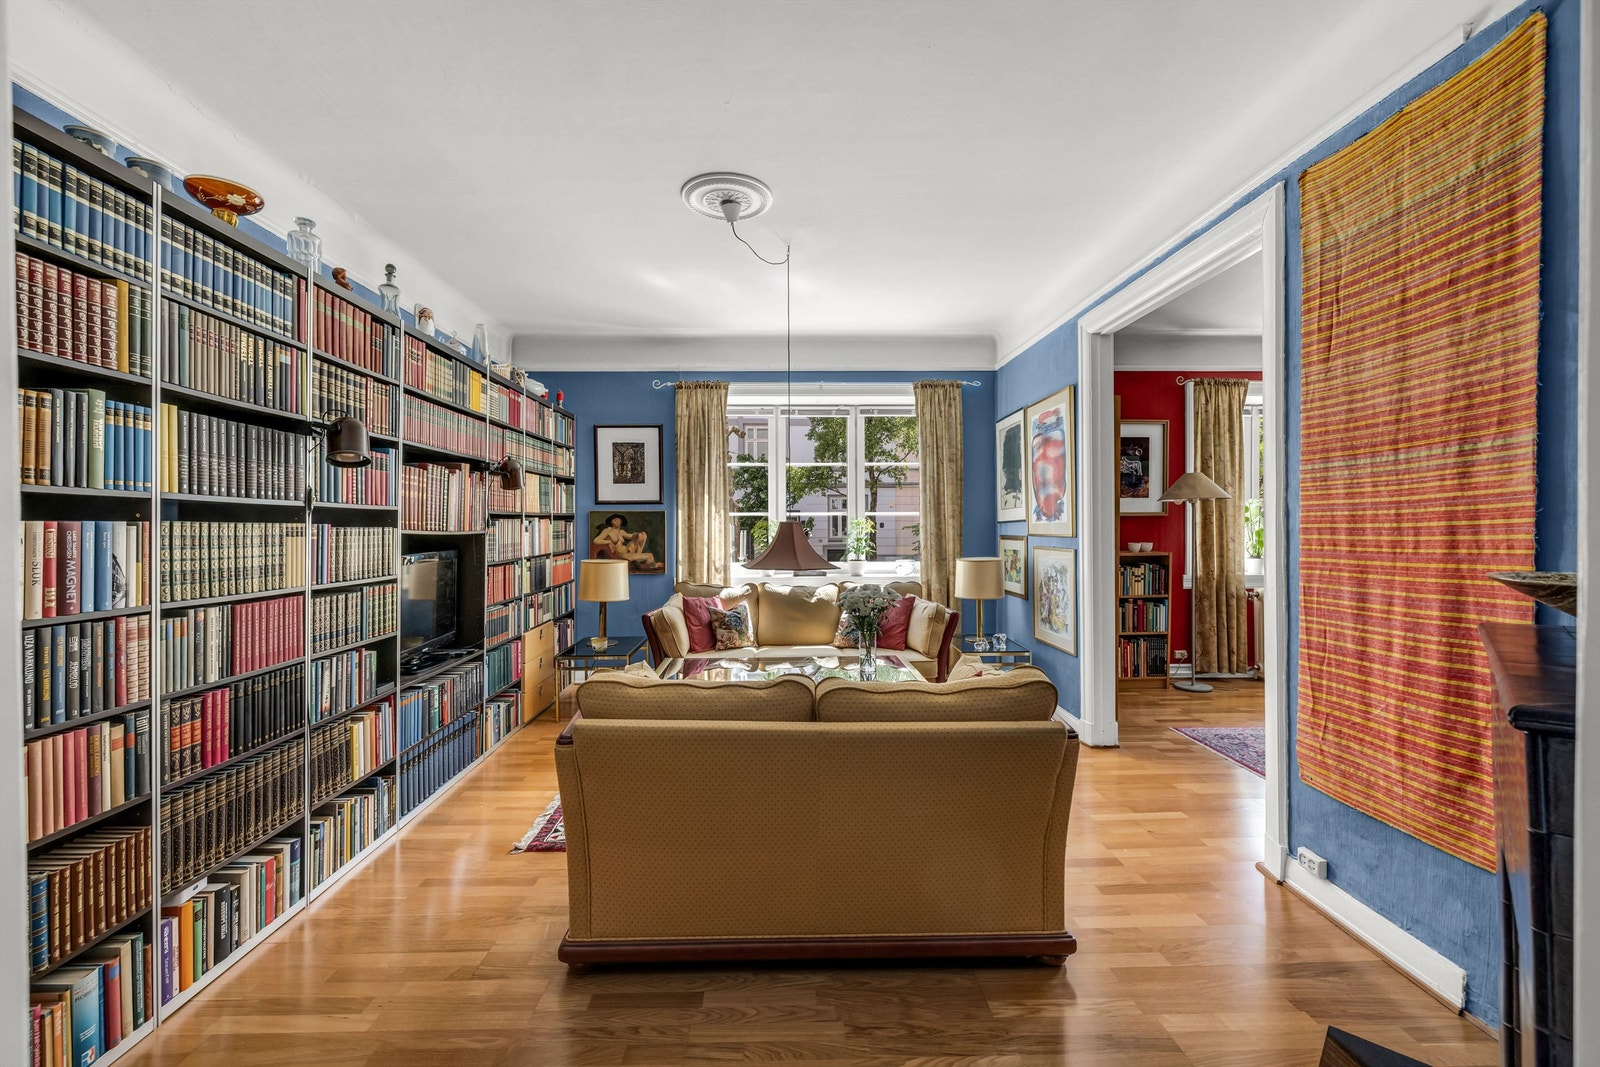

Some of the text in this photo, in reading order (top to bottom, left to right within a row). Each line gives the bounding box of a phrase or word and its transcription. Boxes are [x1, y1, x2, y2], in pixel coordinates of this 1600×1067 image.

[31, 560, 42, 586] SLUK
[66, 560, 77, 604] MAGNET
[25, 634, 34, 649] LIZA
[25, 648, 34, 684] MARKLUND
